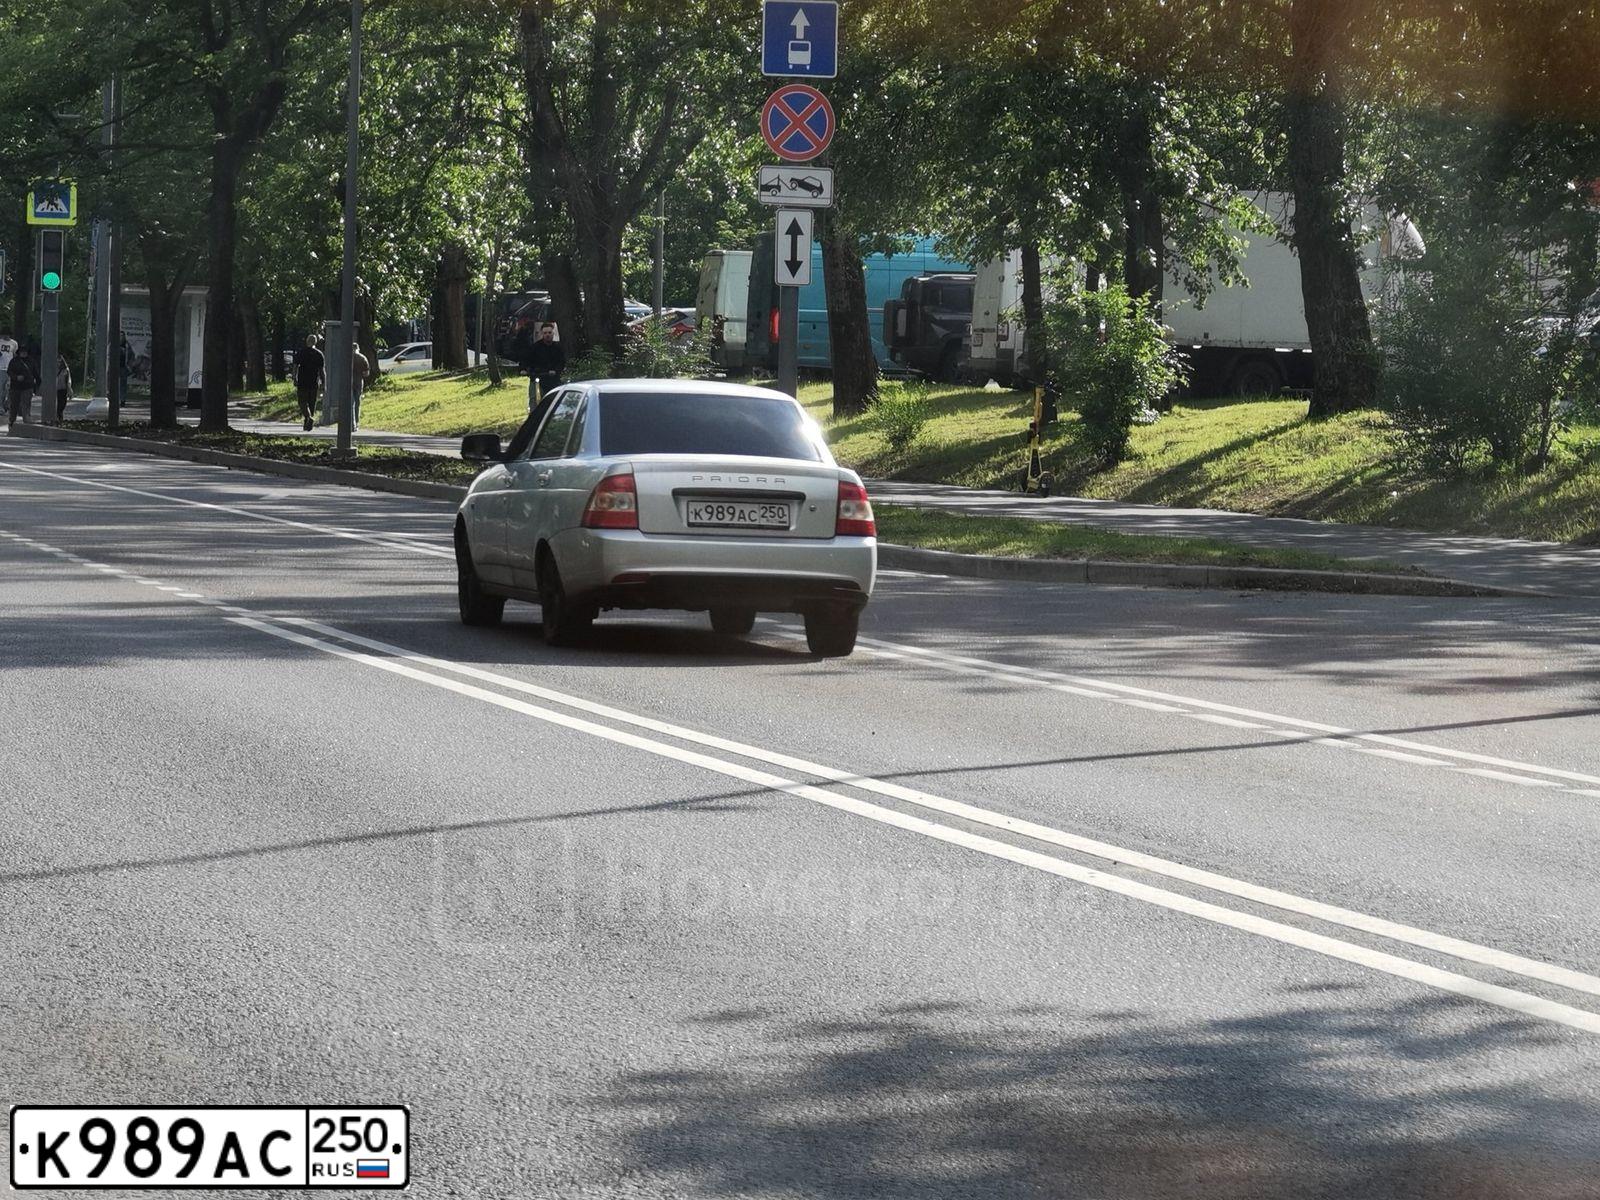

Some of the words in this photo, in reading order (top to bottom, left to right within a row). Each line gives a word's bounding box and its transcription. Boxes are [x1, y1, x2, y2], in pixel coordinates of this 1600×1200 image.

[692, 475, 786, 484] PRIORA
[693, 504, 758, 522] К989АС
[760, 505, 785, 519] 250
